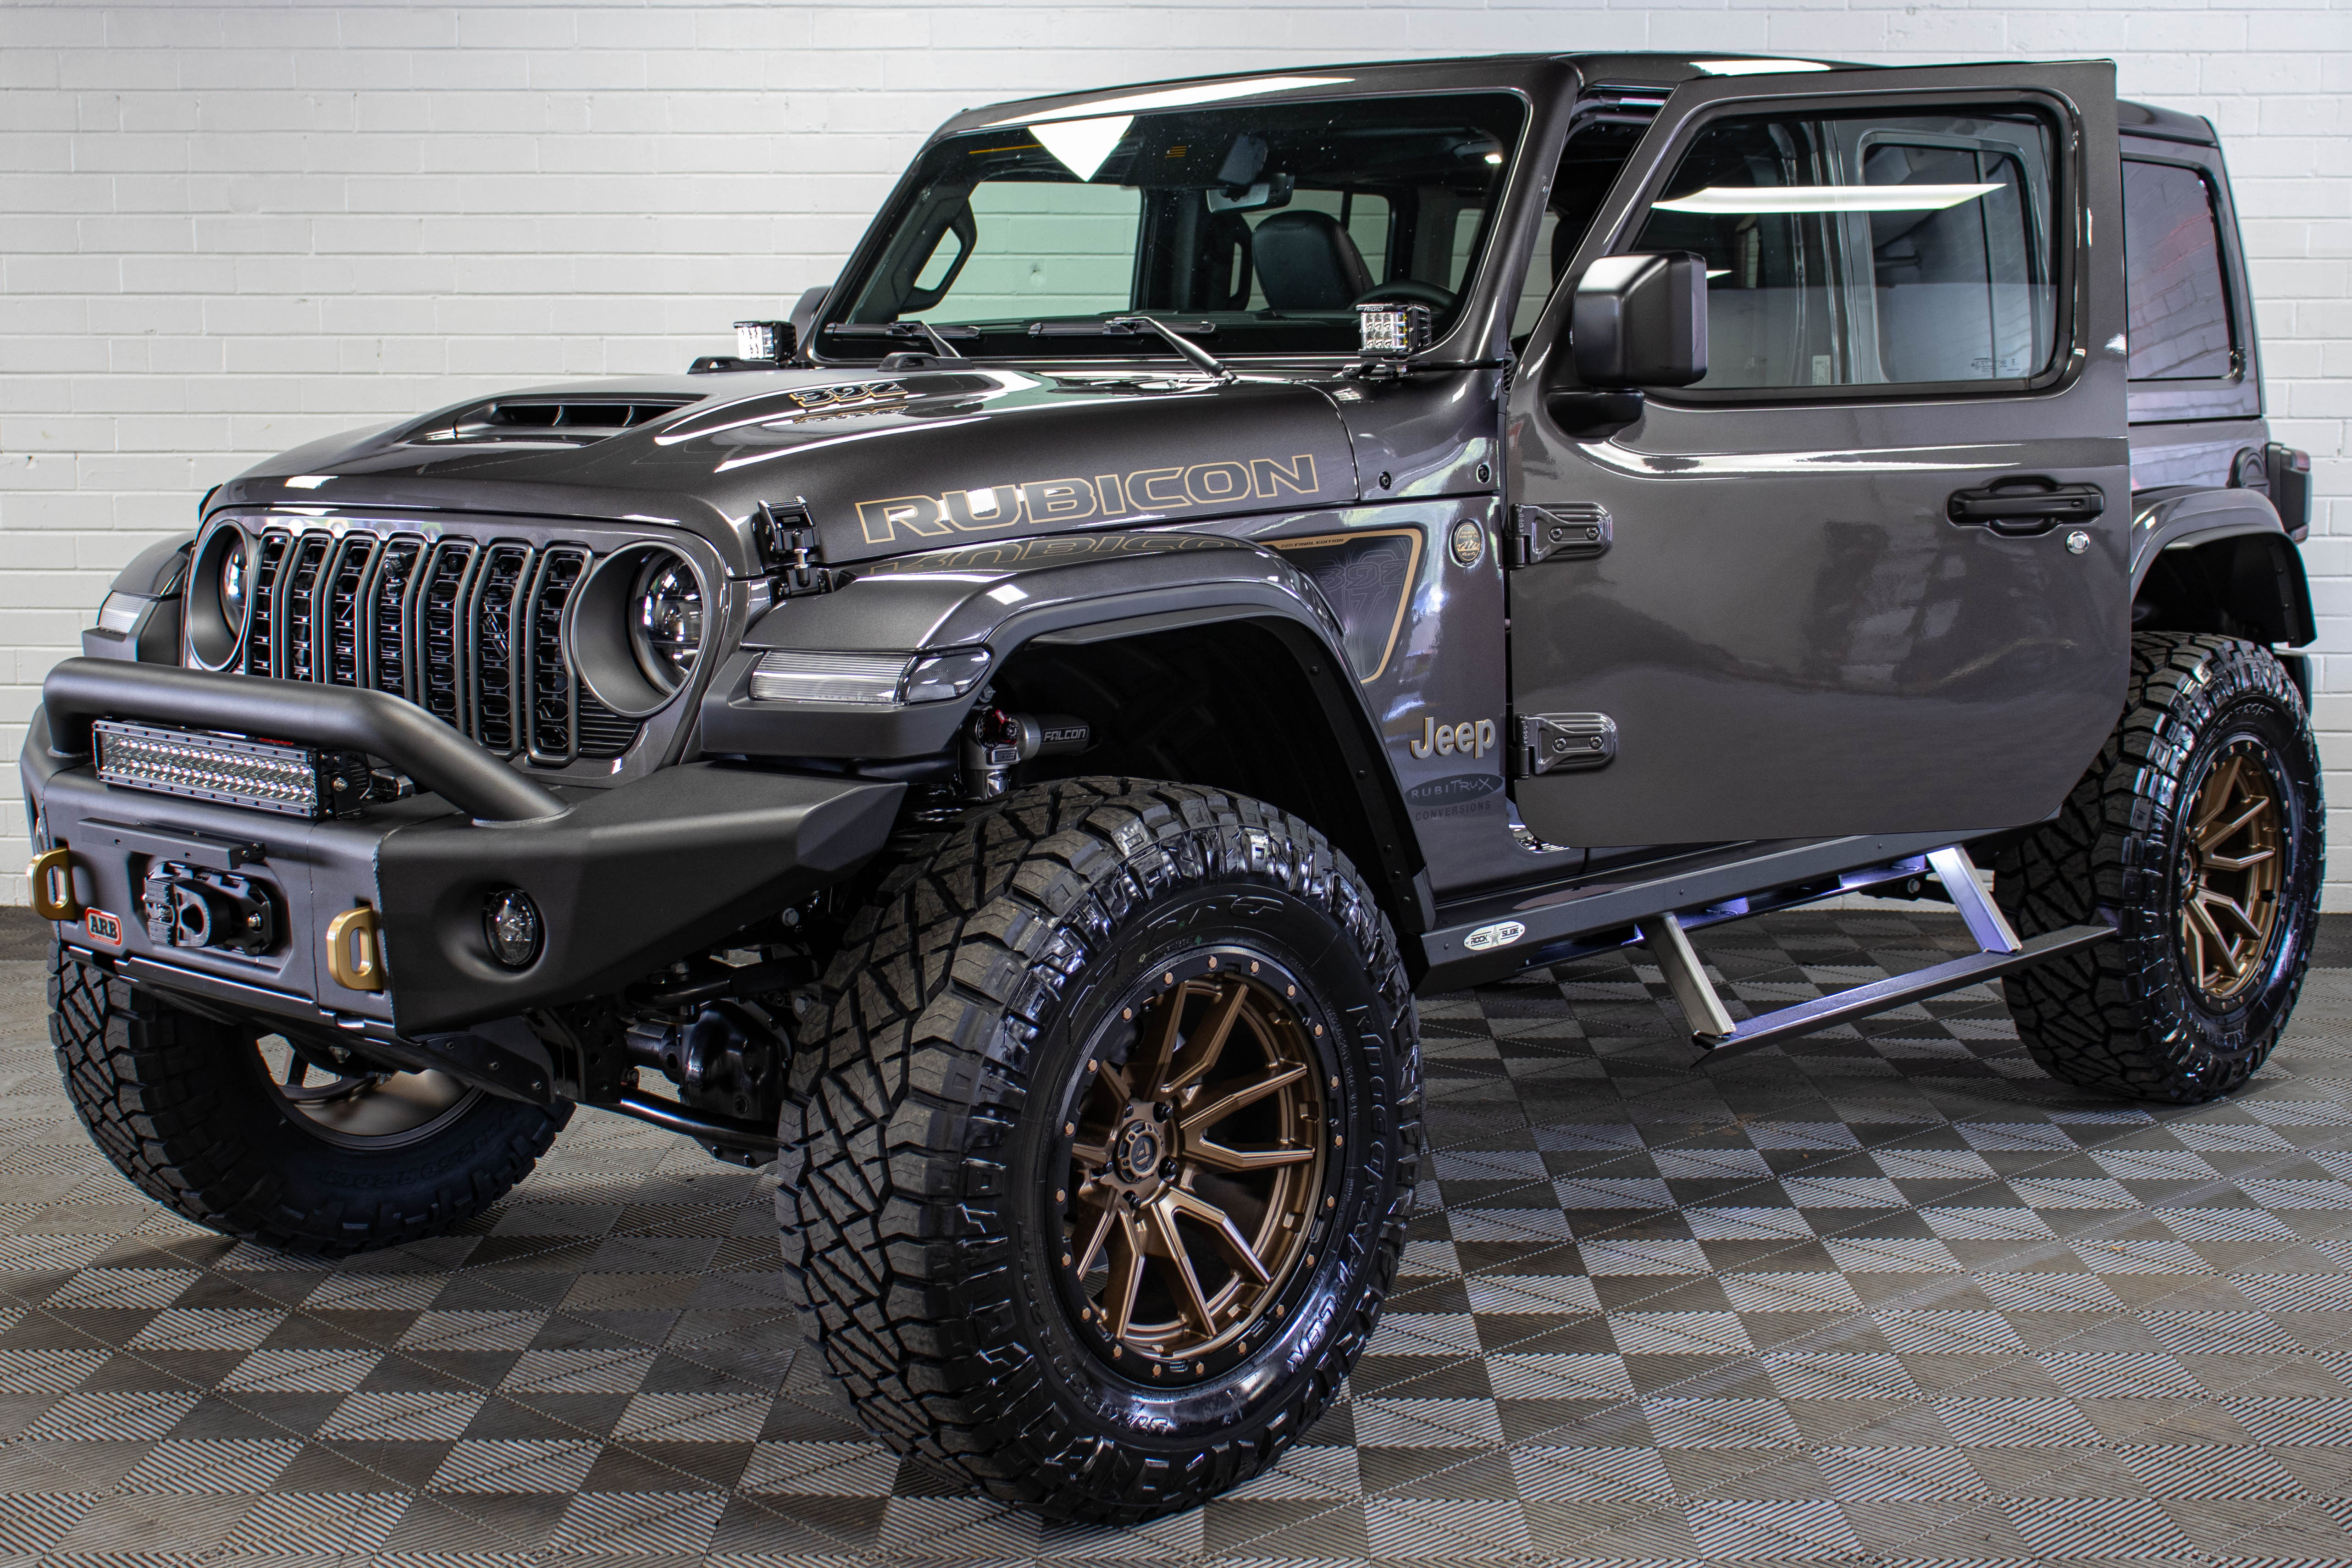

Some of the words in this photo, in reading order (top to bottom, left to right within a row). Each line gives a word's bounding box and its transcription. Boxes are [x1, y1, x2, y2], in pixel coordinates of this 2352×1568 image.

[789, 381, 908, 408] 392
[855, 454, 1319, 544] RUBICON
[1043, 728, 1086, 742] FALCON
[1411, 717, 1496, 759] Jeep
[1415, 801, 1491, 821] CONVERSIONS
[90, 915, 118, 939] ARB
[1471, 934, 1489, 944] ROCK
[1502, 925, 1519, 937] SLIDE
